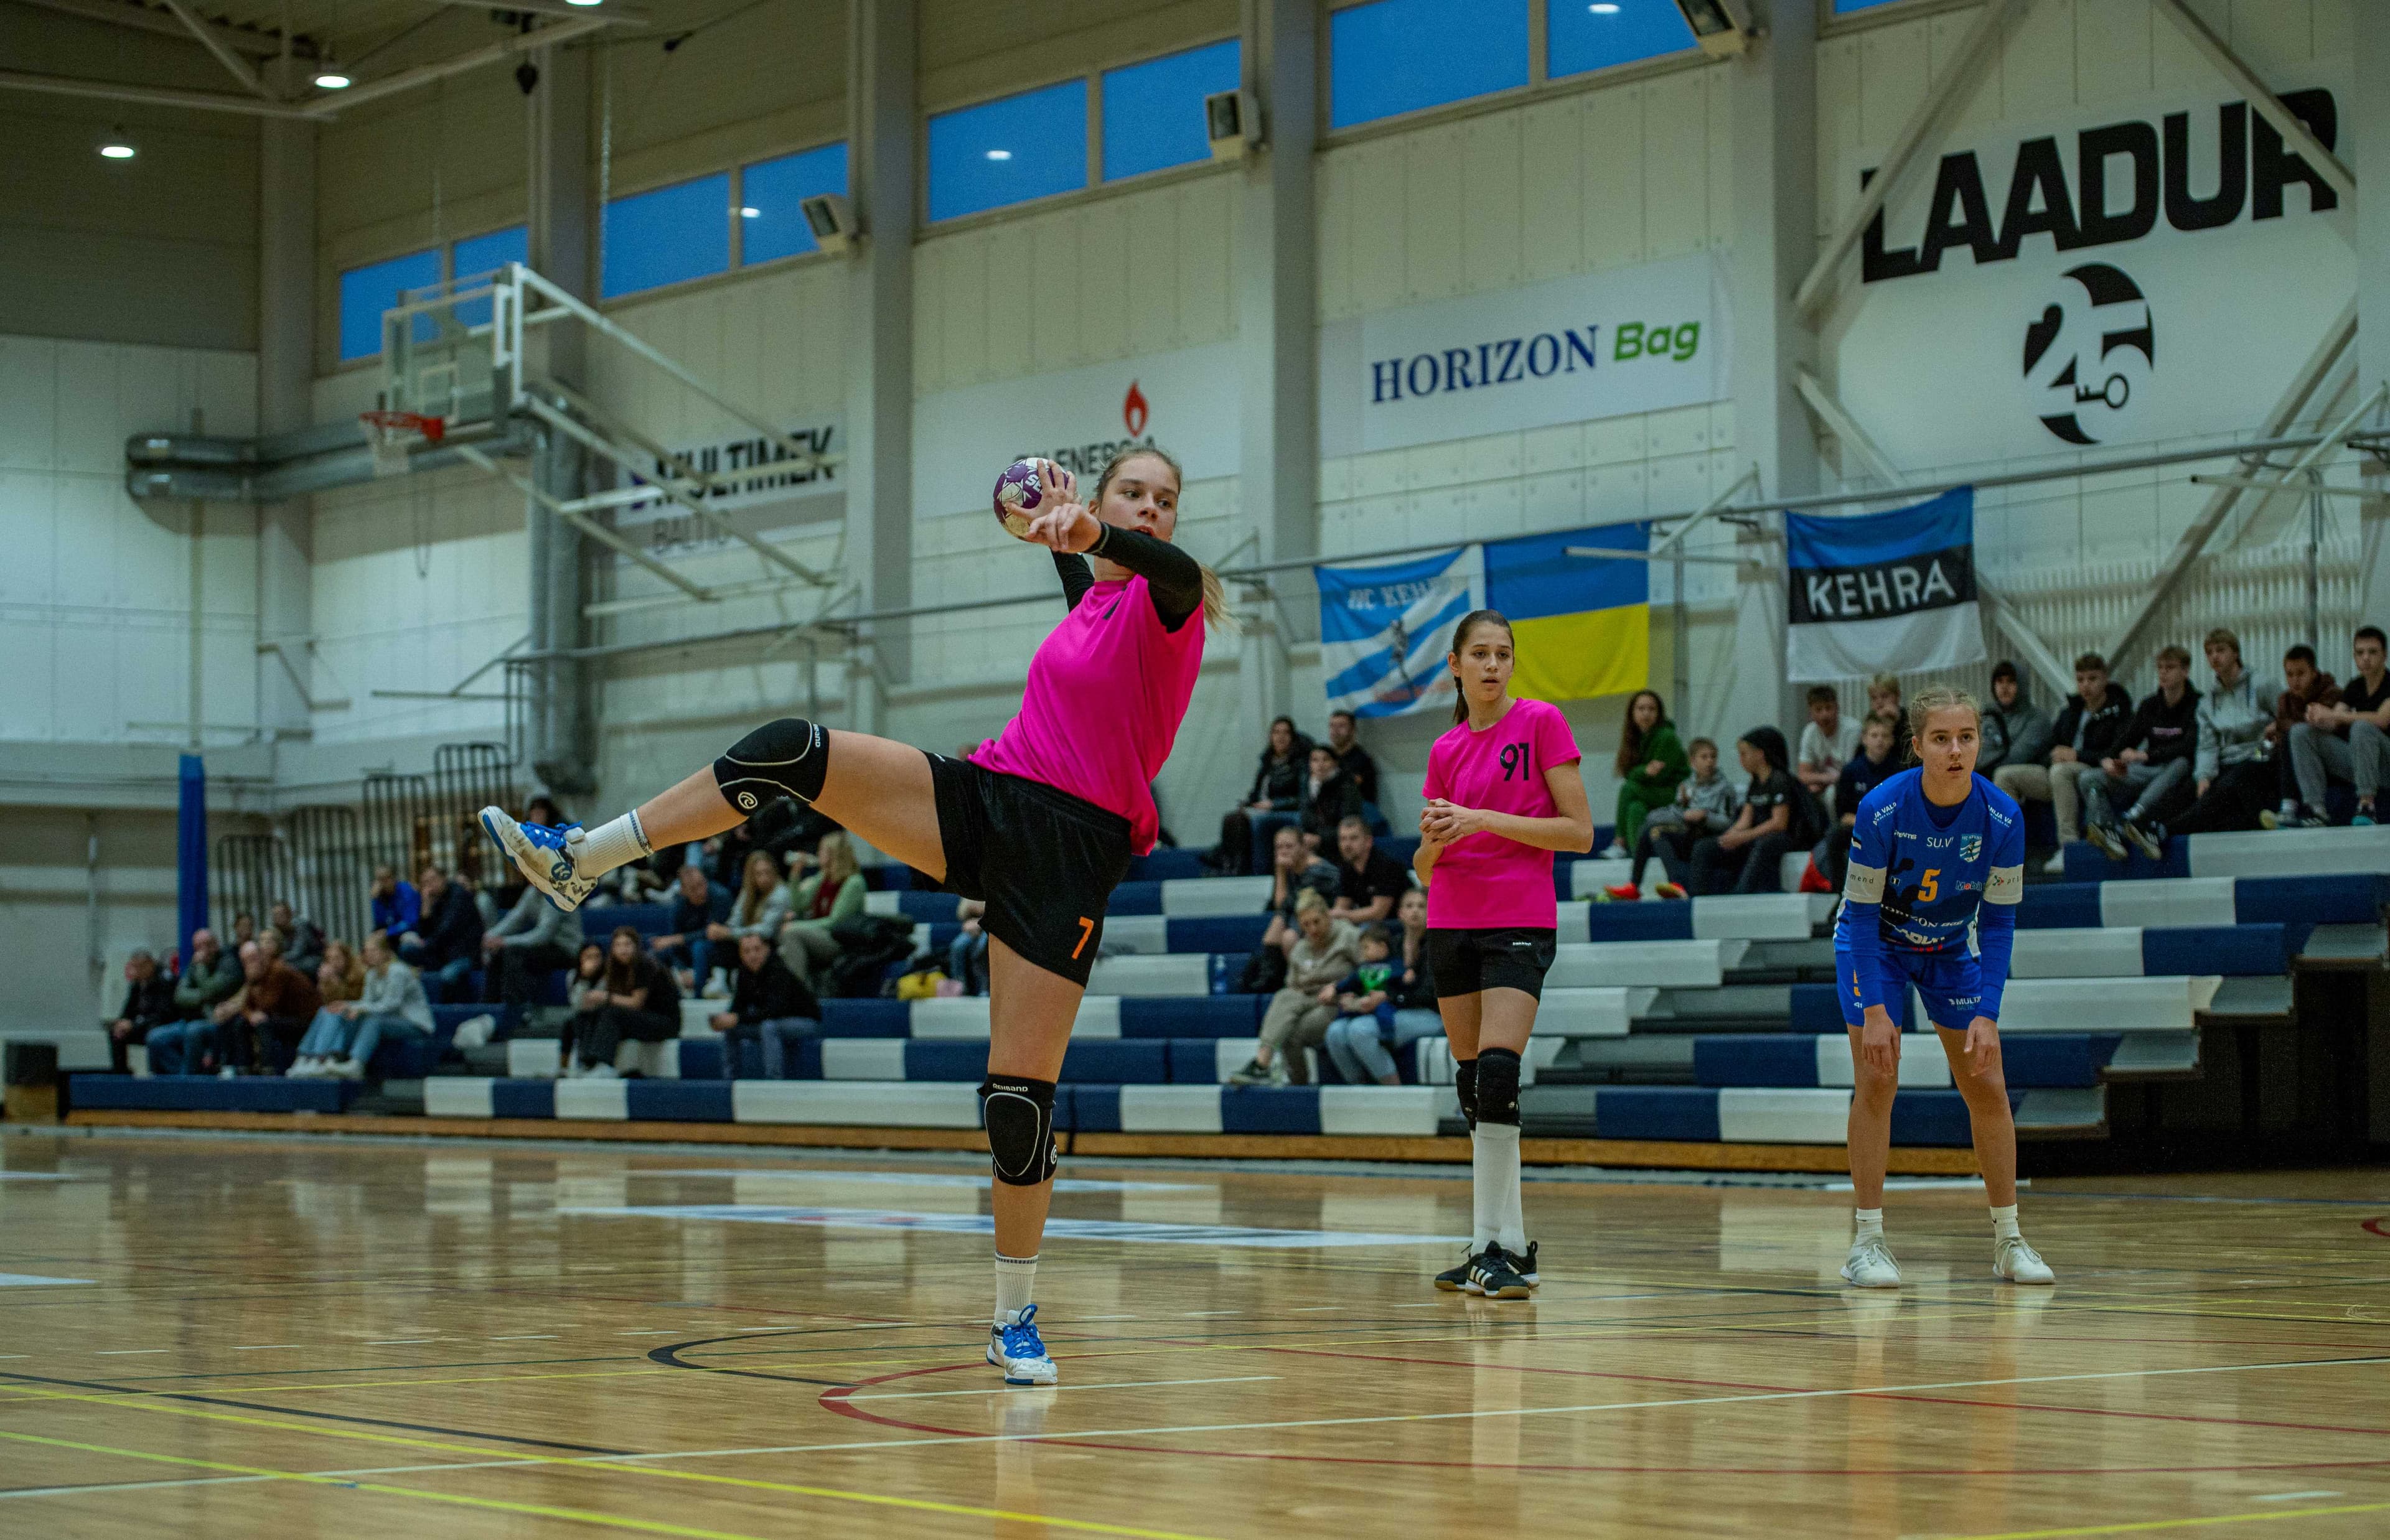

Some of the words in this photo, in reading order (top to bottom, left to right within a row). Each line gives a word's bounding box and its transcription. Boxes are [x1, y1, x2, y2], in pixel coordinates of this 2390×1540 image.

[1862, 87, 2338, 284] LAADUR
[1371, 325, 1598, 404] HORIZON
[1613, 320, 1701, 362] Bag
[1055, 436, 1156, 475] ENER
[1807, 559, 1956, 616] KEHRA
[1499, 742, 1530, 782] 91
[1918, 868, 1941, 902] 5
[1072, 916, 1094, 959] 7
